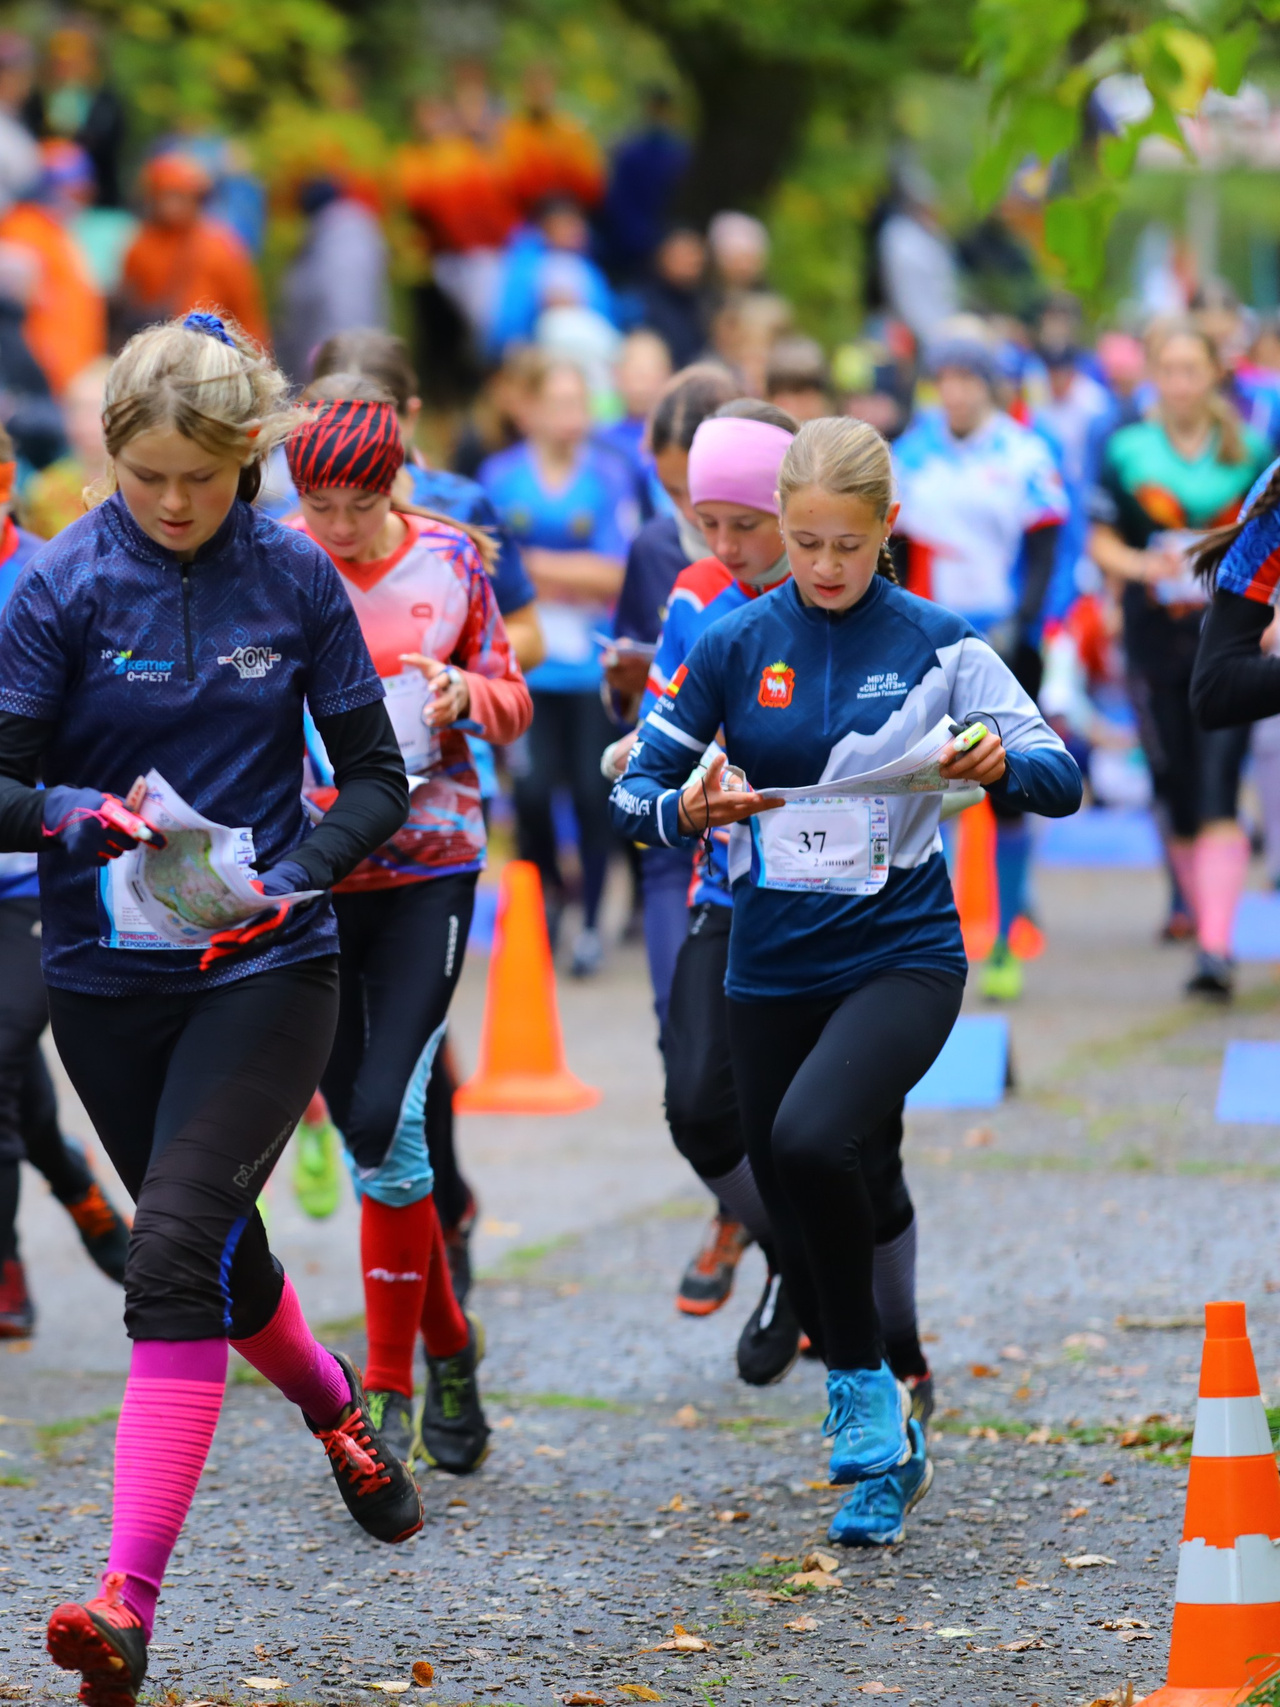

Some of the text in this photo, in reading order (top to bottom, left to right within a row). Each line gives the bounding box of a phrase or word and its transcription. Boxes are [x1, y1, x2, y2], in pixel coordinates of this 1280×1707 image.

[126, 671, 172, 682] O-FEST
[867, 674, 884, 684] МБУ
[798, 831, 827, 854] 37
[813, 859, 819, 867] 2
